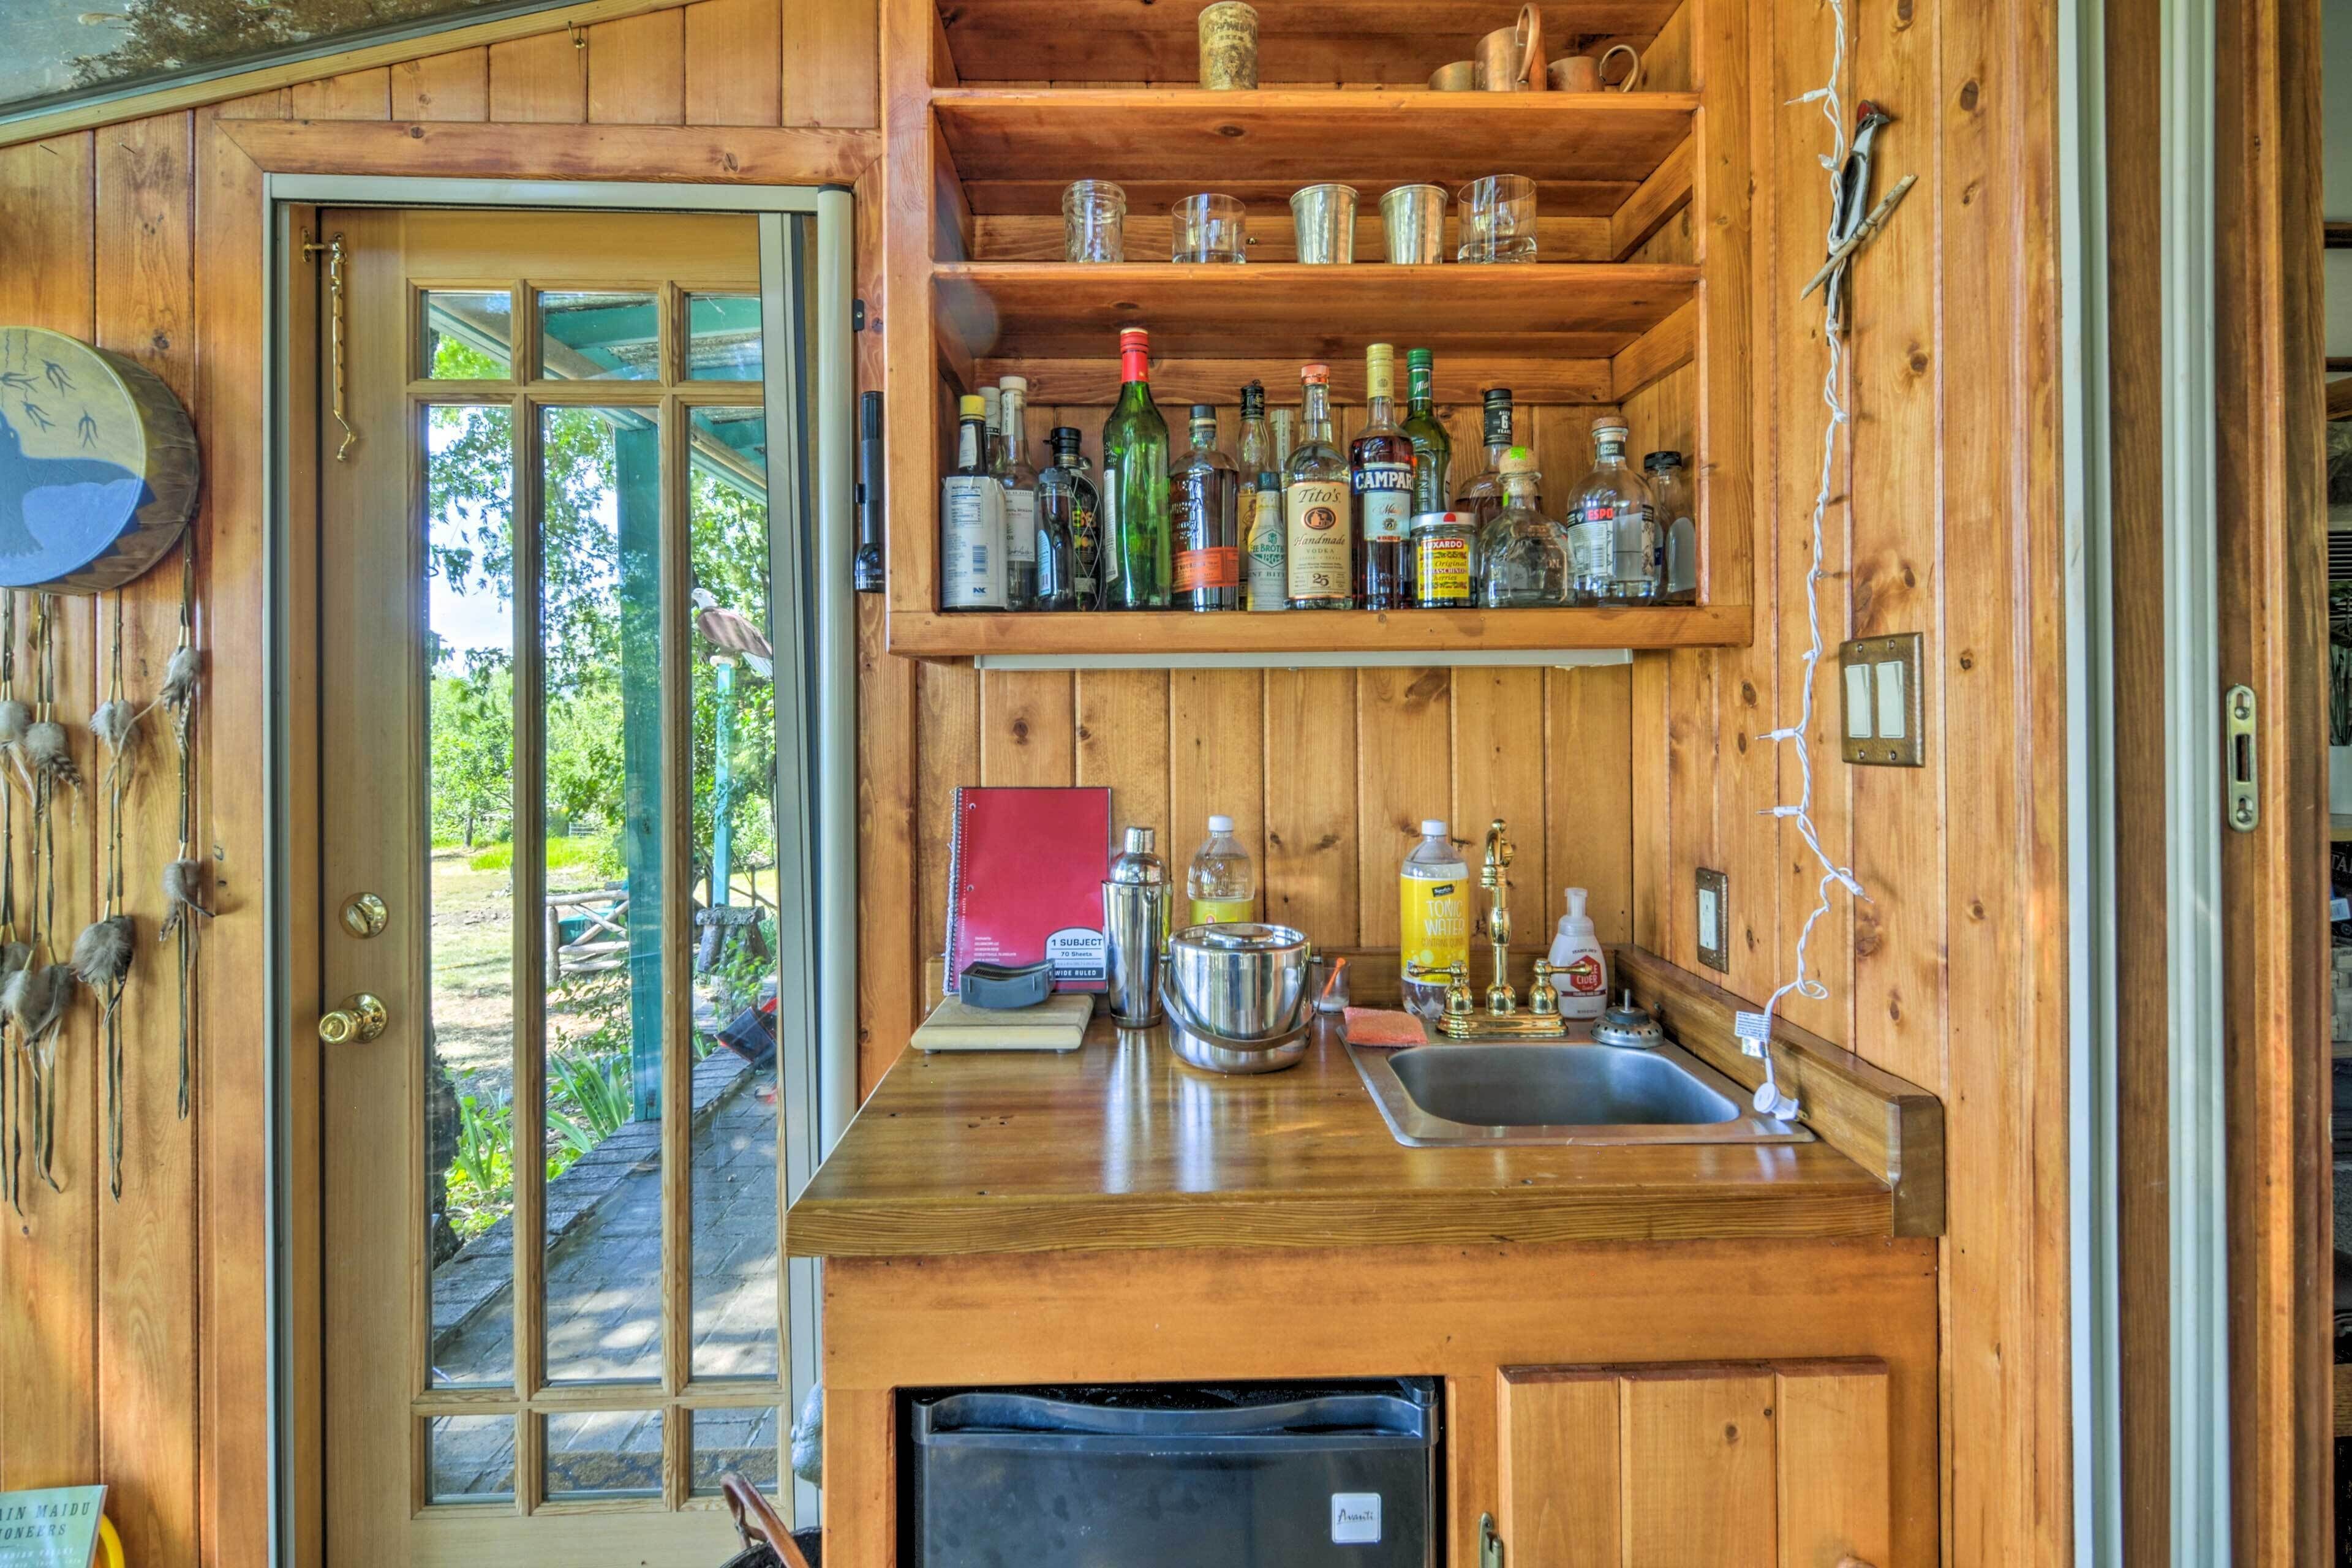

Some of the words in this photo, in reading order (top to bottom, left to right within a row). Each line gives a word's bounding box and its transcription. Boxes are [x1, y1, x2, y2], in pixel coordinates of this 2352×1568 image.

[1501, 415, 1509, 429] 6
[1298, 486, 1340, 503] Tito's
[1588, 508, 1614, 520] ESPO
[1294, 533, 1345, 546] Handmade
[1313, 573, 1329, 586] 25
[1426, 899, 1463, 918] TONIC
[1425, 918, 1466, 937] WATER
[1577, 975, 1597, 984] CIDER
[36, 1502, 90, 1518] MAIDU
[1338, 1508, 1374, 1523] Avanti
[0, 1524, 66, 1540] ONEERS
